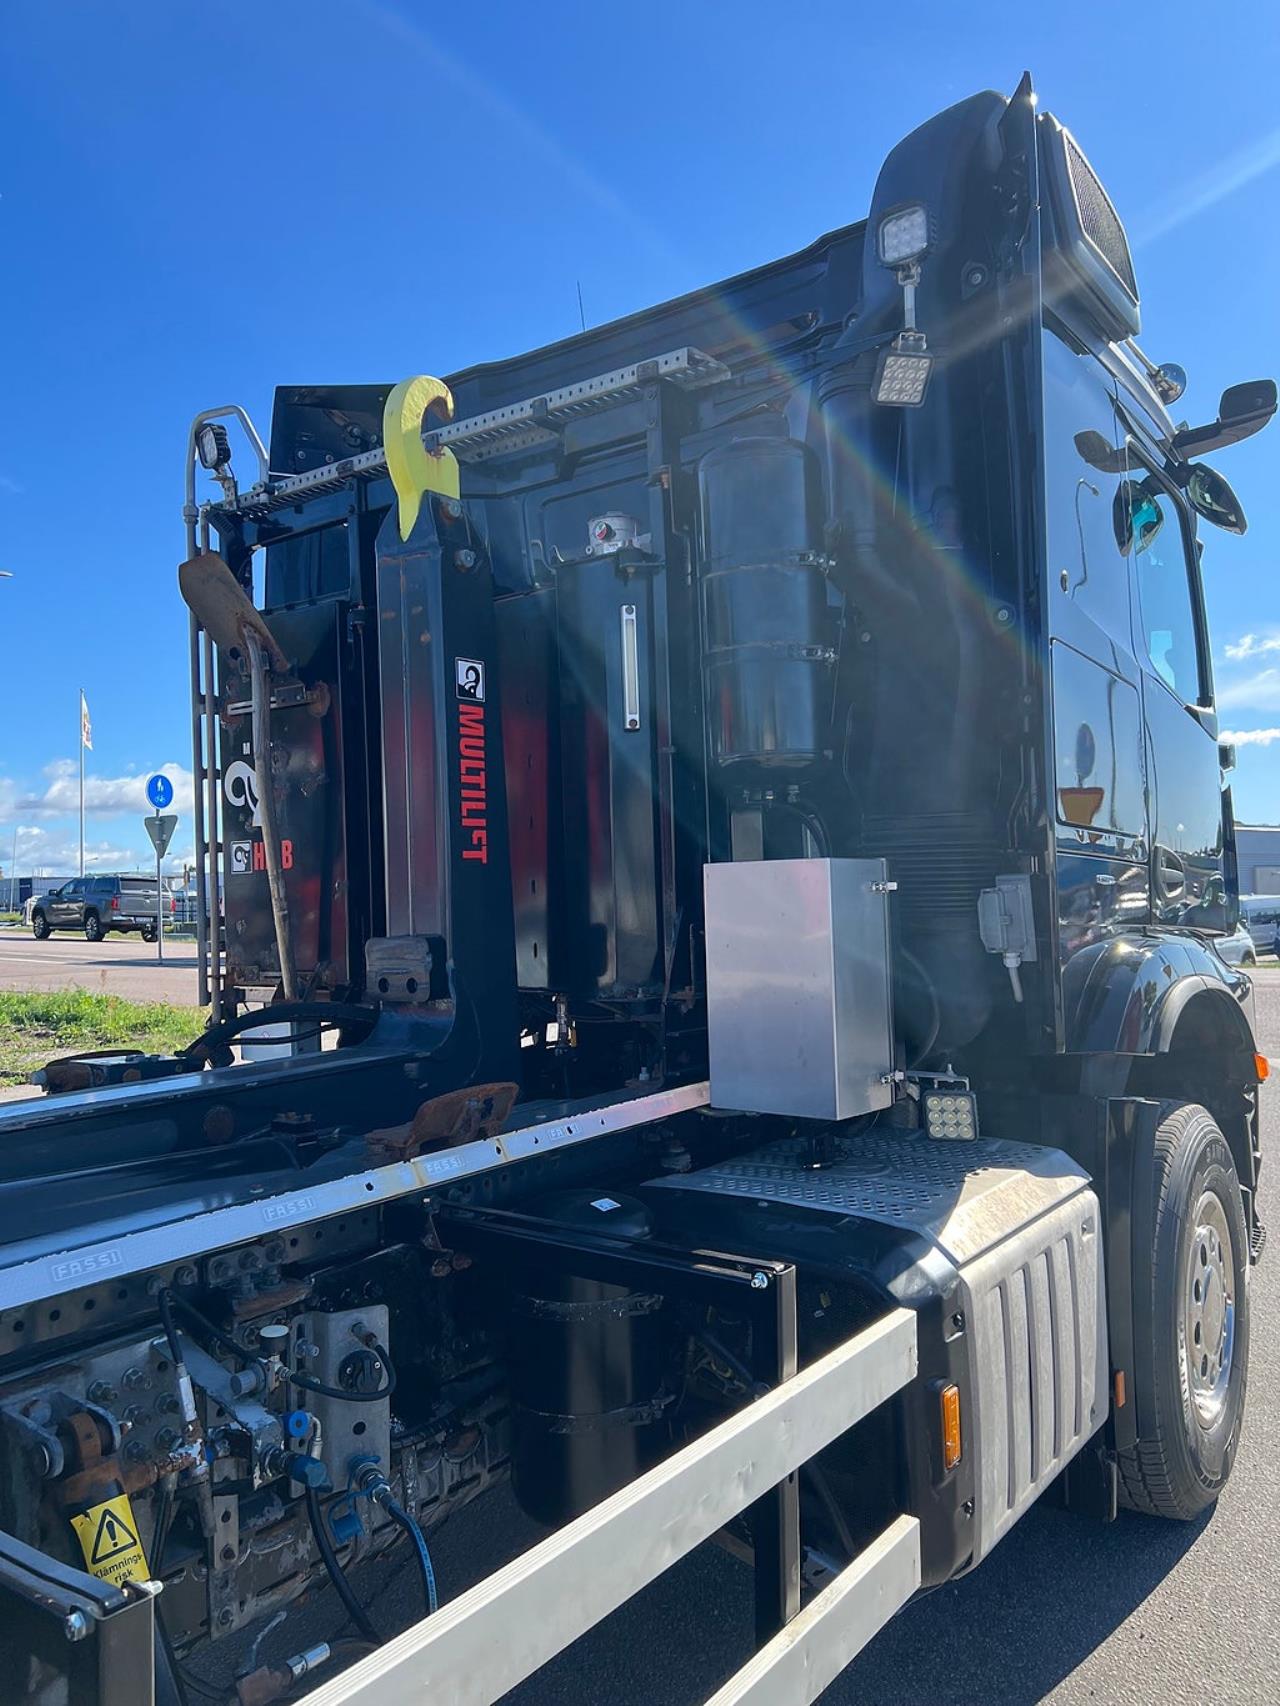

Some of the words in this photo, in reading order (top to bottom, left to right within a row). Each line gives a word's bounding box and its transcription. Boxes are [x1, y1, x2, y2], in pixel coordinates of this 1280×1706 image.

[459, 704, 487, 864] MULTILIFT
[253, 840, 293, 870] HB
[425, 1156, 463, 1173] FASSI
[268, 1197, 314, 1219] FASSI
[56, 1250, 119, 1278] FASSI
[114, 1569, 134, 1584] risk
